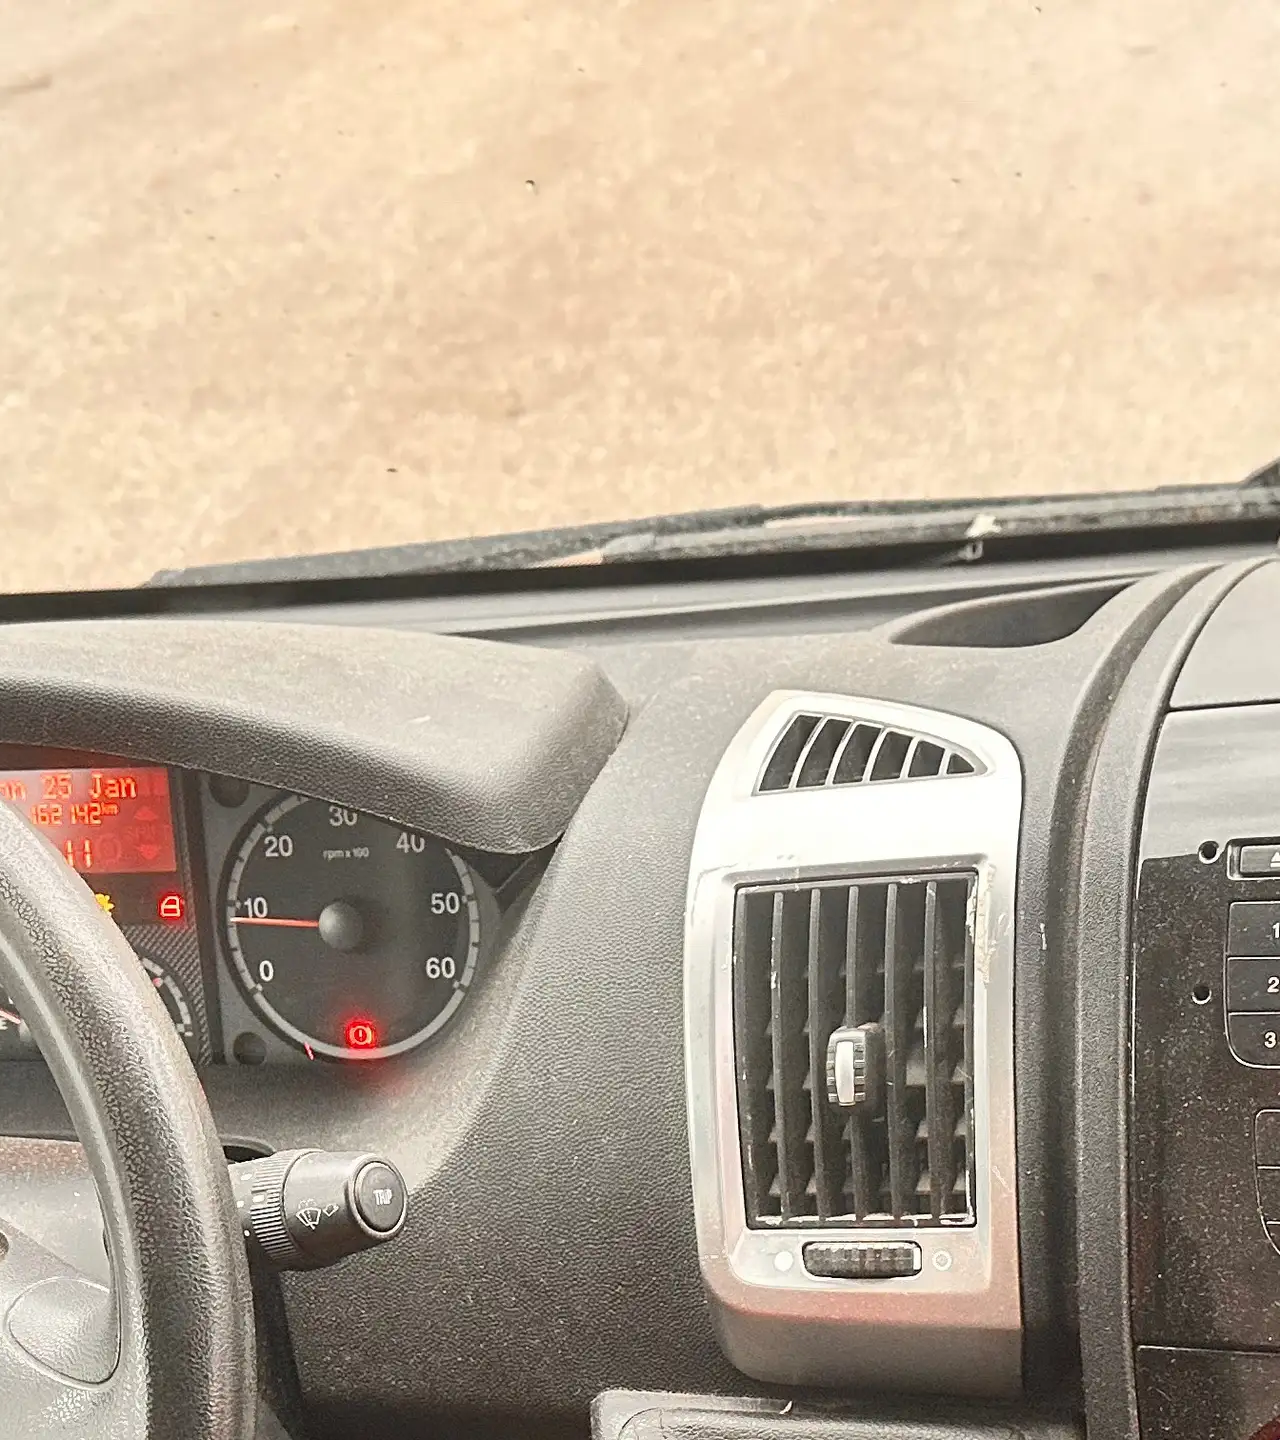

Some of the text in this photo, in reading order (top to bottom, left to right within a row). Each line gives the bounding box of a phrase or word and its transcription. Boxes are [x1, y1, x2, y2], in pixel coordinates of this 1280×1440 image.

[40, 772, 72, 799] 25
[89, 771, 137, 799] Jan
[328, 805, 358, 827] 30
[264, 835, 293, 858] 20
[396, 831, 425, 853] 40
[244, 897, 268, 918] 10
[431, 892, 460, 914] 50
[1272, 922, 1280, 939] 1
[259, 960, 274, 982] 0
[426, 956, 456, 979] 60
[1267, 976, 1280, 993] 2
[1264, 1031, 1277, 1048] 3
